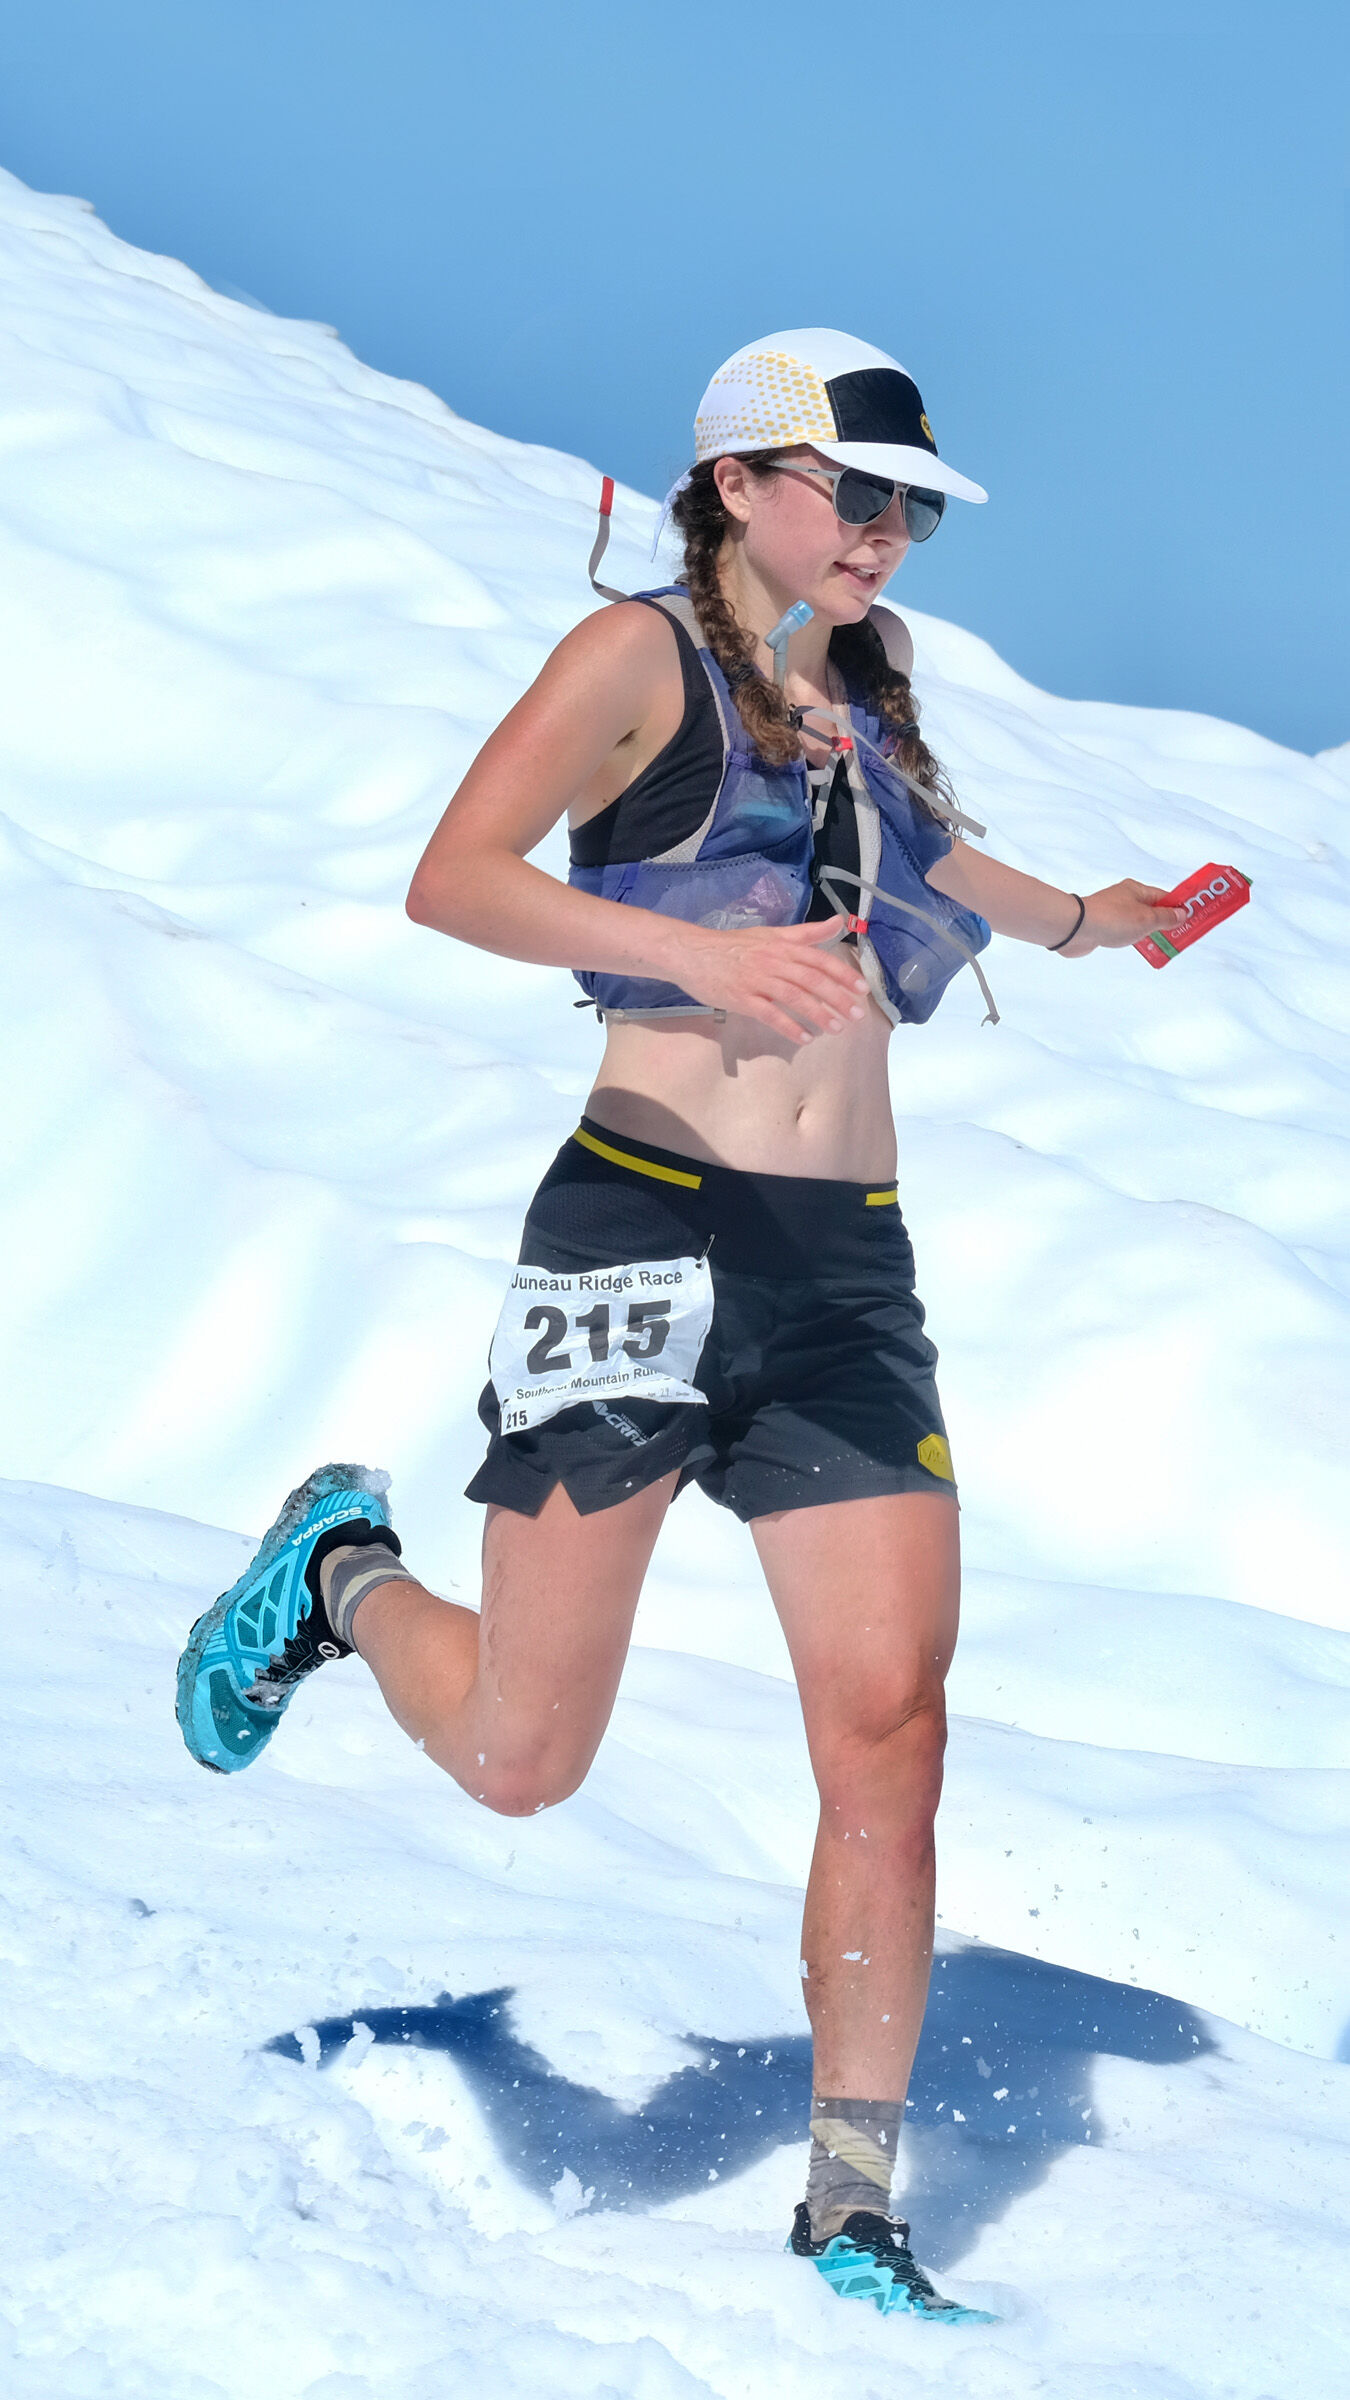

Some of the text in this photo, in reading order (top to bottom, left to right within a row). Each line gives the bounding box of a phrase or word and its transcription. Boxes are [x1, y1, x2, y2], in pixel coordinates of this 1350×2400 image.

[1171, 920, 1193, 938] CHIA
[511, 1270, 683, 1293] Juneau Ridge Race
[524, 1299, 672, 1375] 215
[571, 1371, 630, 1389] Mountain
[506, 1410, 528, 1430] 215
[291, 1506, 363, 1546] SCARPA
